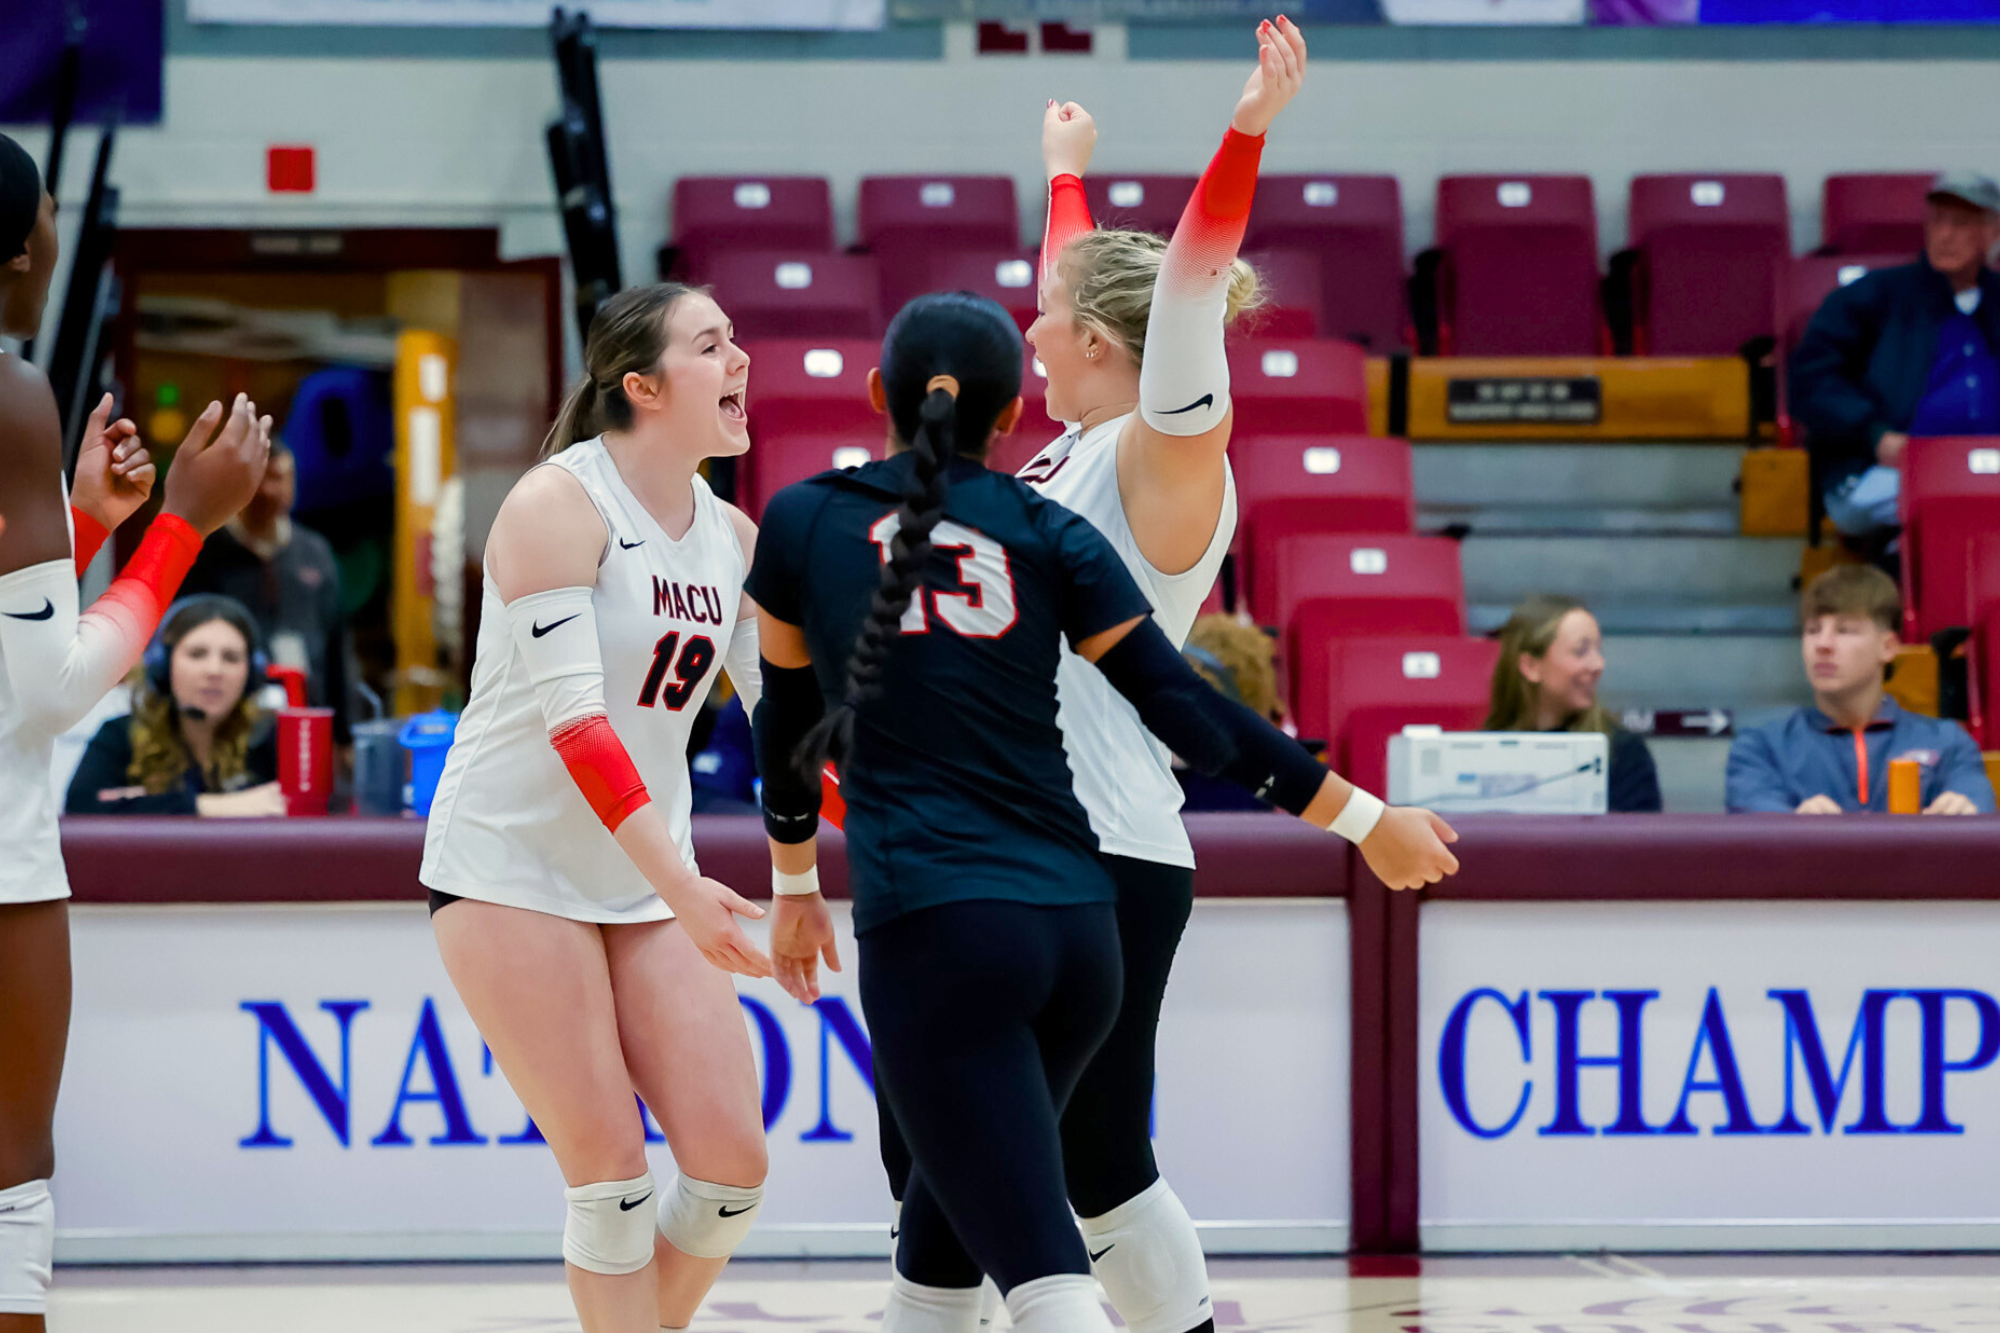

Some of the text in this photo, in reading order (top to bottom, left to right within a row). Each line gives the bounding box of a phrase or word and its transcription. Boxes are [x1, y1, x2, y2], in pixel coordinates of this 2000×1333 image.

[652, 574, 723, 627] MACU
[868, 510, 1020, 639] 13
[637, 630, 716, 712] 19
[1437, 986, 2000, 1140] CHAMP
